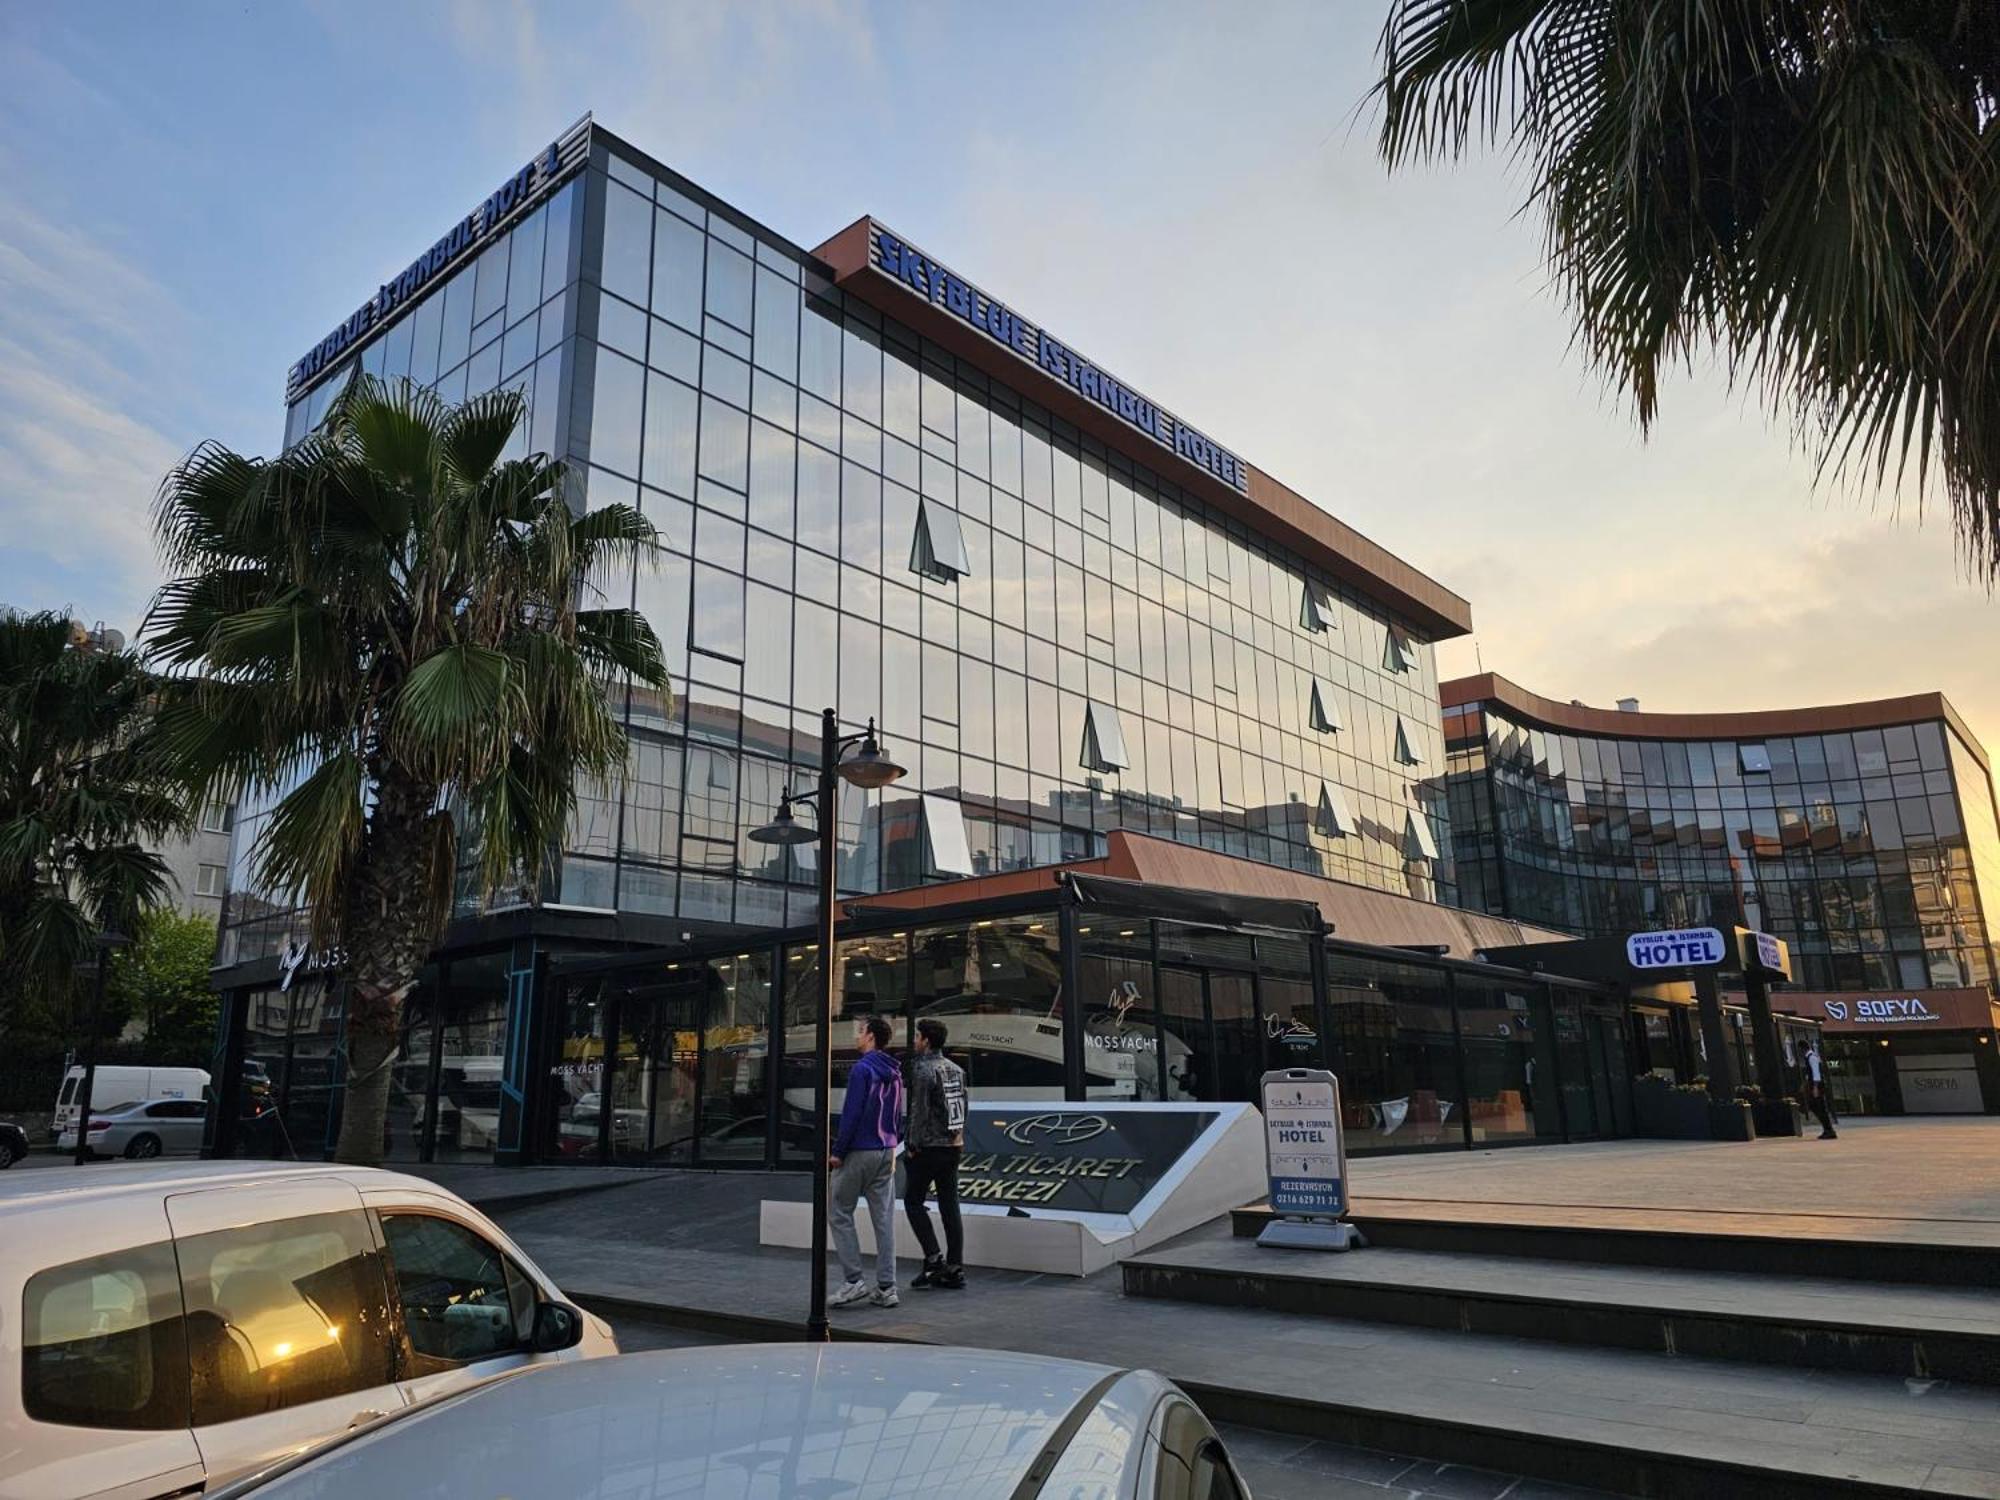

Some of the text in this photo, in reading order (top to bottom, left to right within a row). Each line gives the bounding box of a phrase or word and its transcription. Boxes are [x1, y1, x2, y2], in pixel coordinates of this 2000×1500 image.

[879, 233, 1028, 355] SKYBLUE
[1173, 420, 1247, 492] HOTEL
[1634, 942, 1717, 966] HOTEL
[1856, 998, 1928, 1016] SOFYA
[1279, 1130, 1326, 1143] HOTEL
[1002, 1152, 1145, 1178] TİCARET
